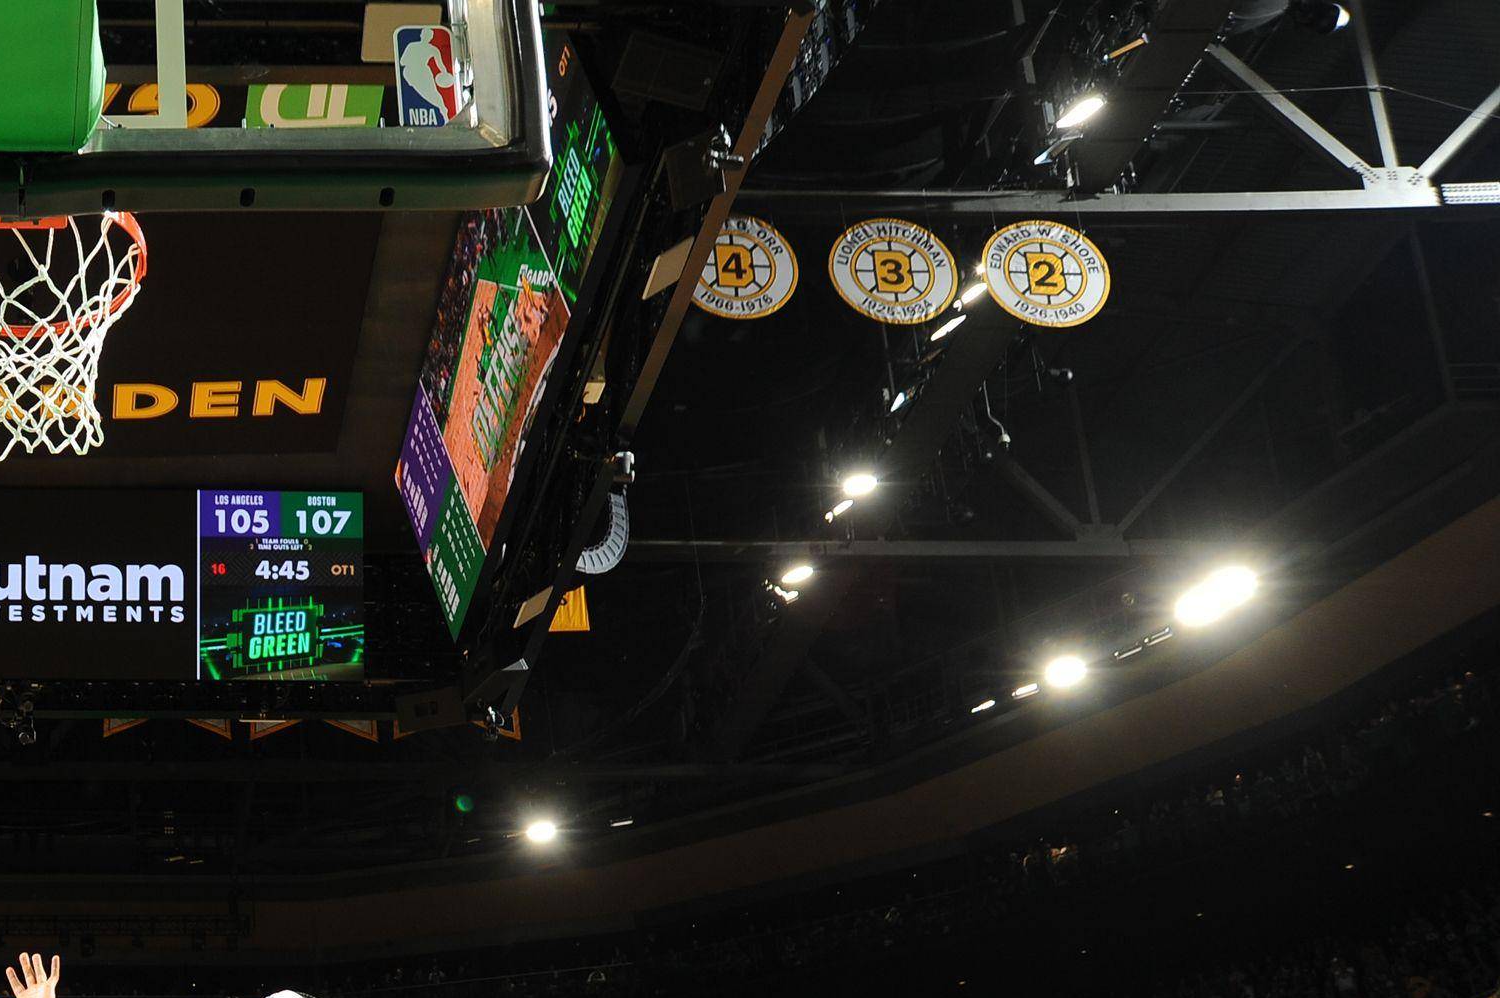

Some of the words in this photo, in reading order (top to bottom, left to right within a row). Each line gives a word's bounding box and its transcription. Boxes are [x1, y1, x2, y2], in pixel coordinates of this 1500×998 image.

[409, 108, 437, 125] NBA
[567, 166, 592, 249] GREEN
[756, 229, 784, 255] ORR
[837, 225, 873, 266] LIONEL
[876, 225, 946, 268] HITCHMAN
[990, 229, 1031, 269] EDWARD
[1060, 235, 1099, 274] SHORE
[722, 252, 747, 279] 4
[880, 259, 905, 285] 3
[1033, 260, 1058, 286] 2
[1015, 300, 1085, 320] 1926-1940
[215, 495, 229, 505] LOS
[231, 495, 263, 505] ANGELES
[307, 496, 336, 506] BOSTON
[215, 509, 269, 534] 105
[296, 510, 352, 535] 107
[211, 564, 226, 575] 16
[255, 560, 310, 580] 4:45
[331, 565, 354, 576] OT1
[254, 611, 306, 635] BLEED
[249, 632, 310, 660] GREEN
